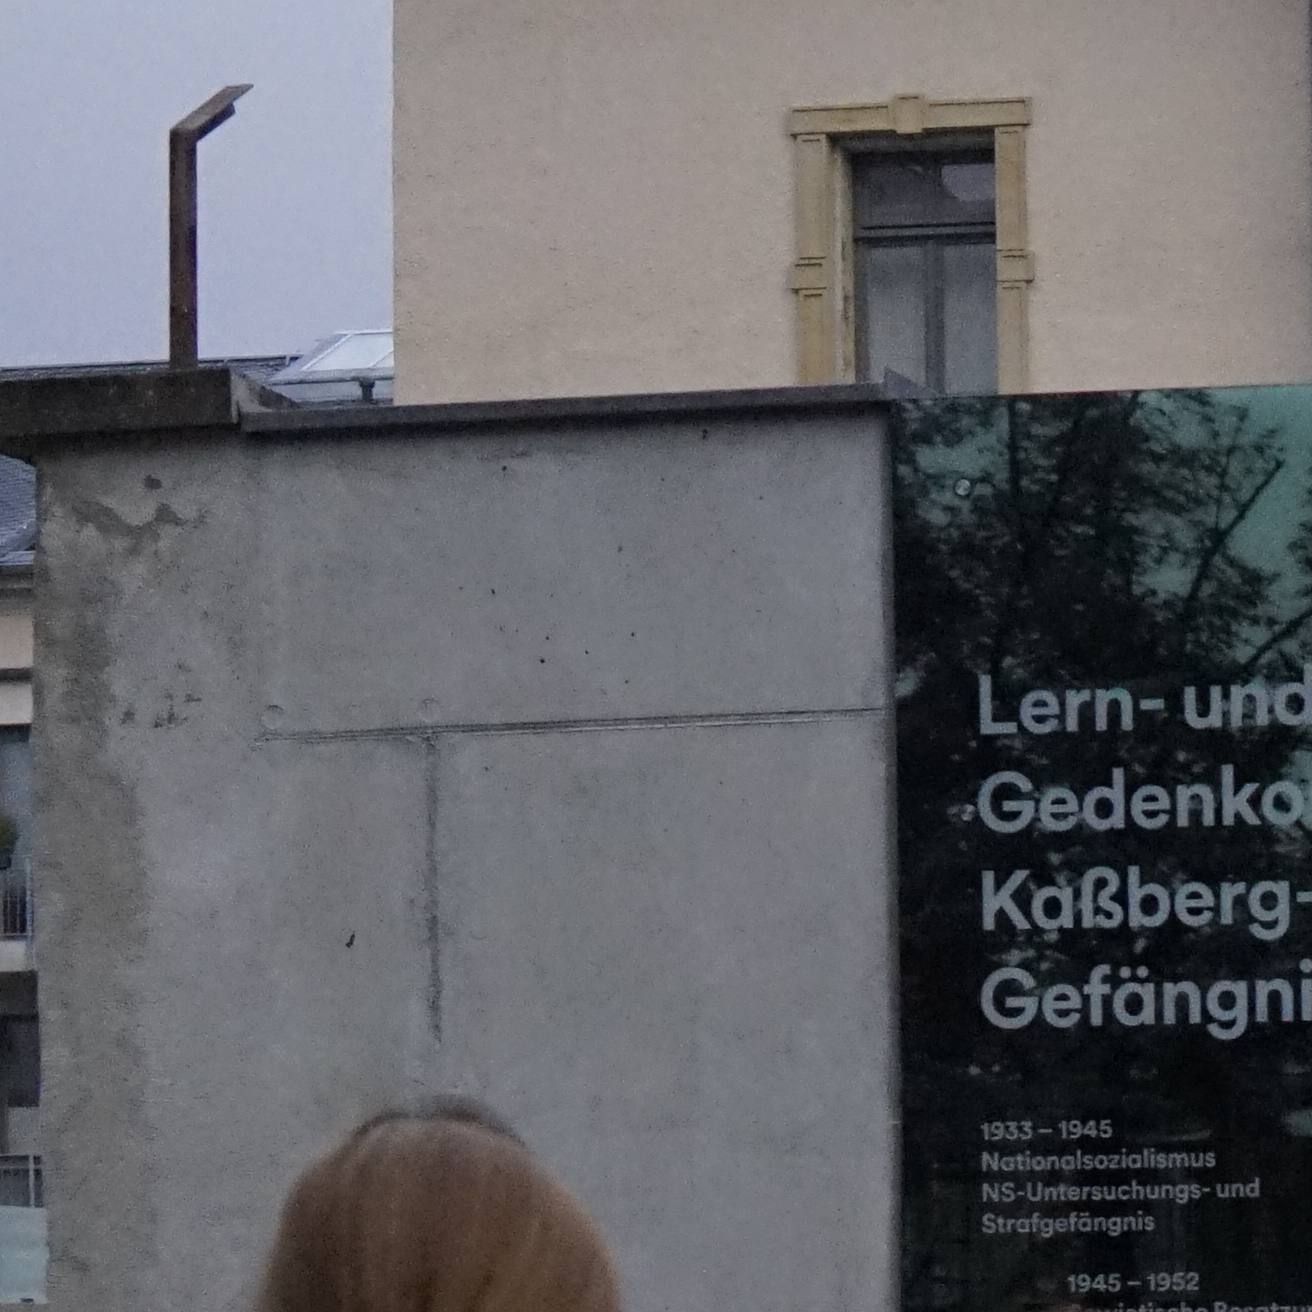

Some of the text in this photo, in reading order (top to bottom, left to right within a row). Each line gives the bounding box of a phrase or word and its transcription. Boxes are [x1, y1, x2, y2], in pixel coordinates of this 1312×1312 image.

[978, 675, 1165, 736] Lern-
[979, 1120, 1033, 1141] 1933
[1057, 1119, 1114, 1140] 1945
[980, 1148, 1217, 1172] Nationalsozialismus
[981, 1177, 1261, 1204] NS-Untersuchungs- und
[980, 1209, 1156, 1237] Strafgefängnis
[1065, 1273, 1122, 1293] 1945
[1146, 1271, 1201, 1292] 1952
